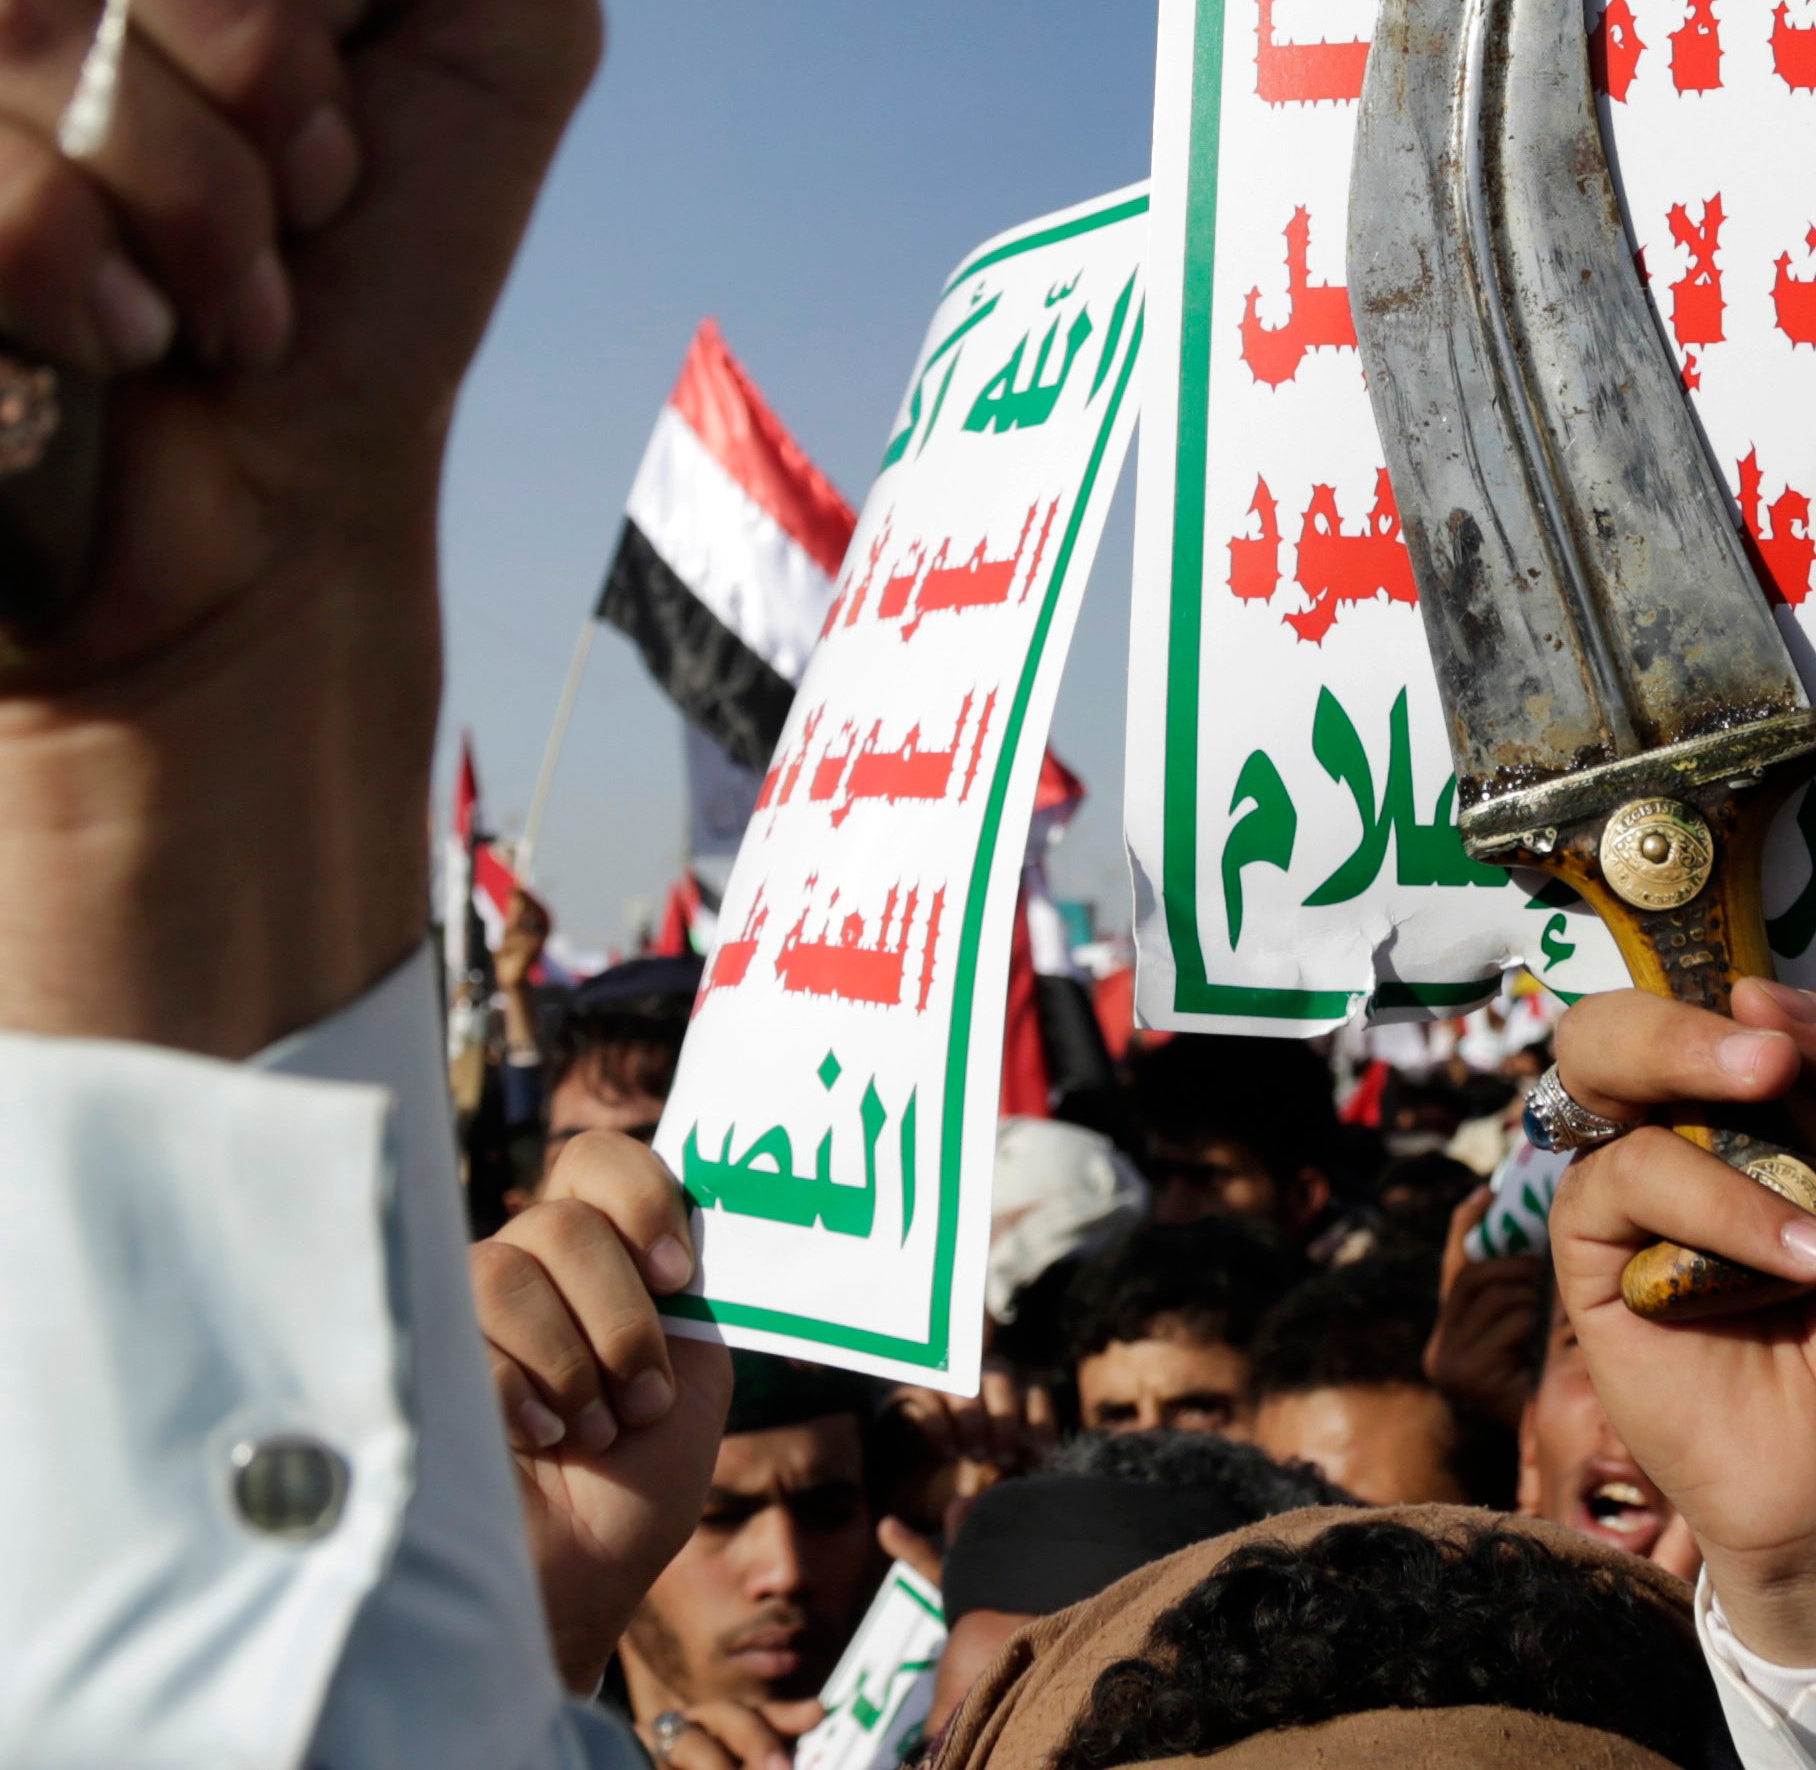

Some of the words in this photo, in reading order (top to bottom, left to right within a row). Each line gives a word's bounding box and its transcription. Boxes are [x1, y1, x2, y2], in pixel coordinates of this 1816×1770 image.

[876, 485, 1064, 646] الموت
[808, 677, 1001, 832] الموت
[773, 868, 948, 1018] اللعنة
